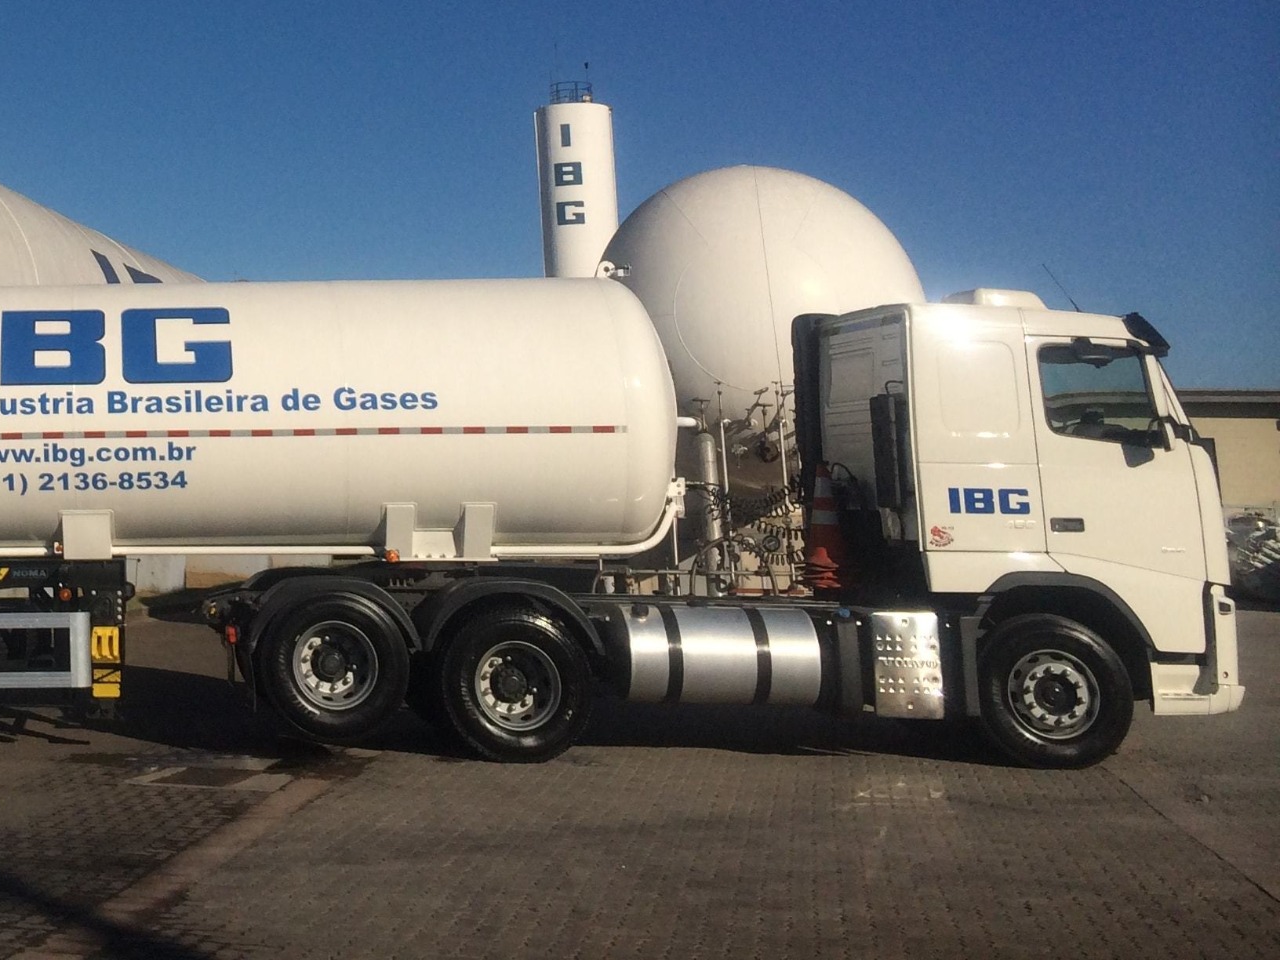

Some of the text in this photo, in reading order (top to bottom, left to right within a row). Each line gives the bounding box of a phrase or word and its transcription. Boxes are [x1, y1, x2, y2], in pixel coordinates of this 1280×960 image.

[554, 124, 586, 226] IBG
[106, 390, 270, 415] Brasileira
[280, 388, 321, 412] de
[332, 387, 439, 411] Gases
[38, 471, 188, 492] 2136-8534
[948, 487, 1031, 515] IBG
